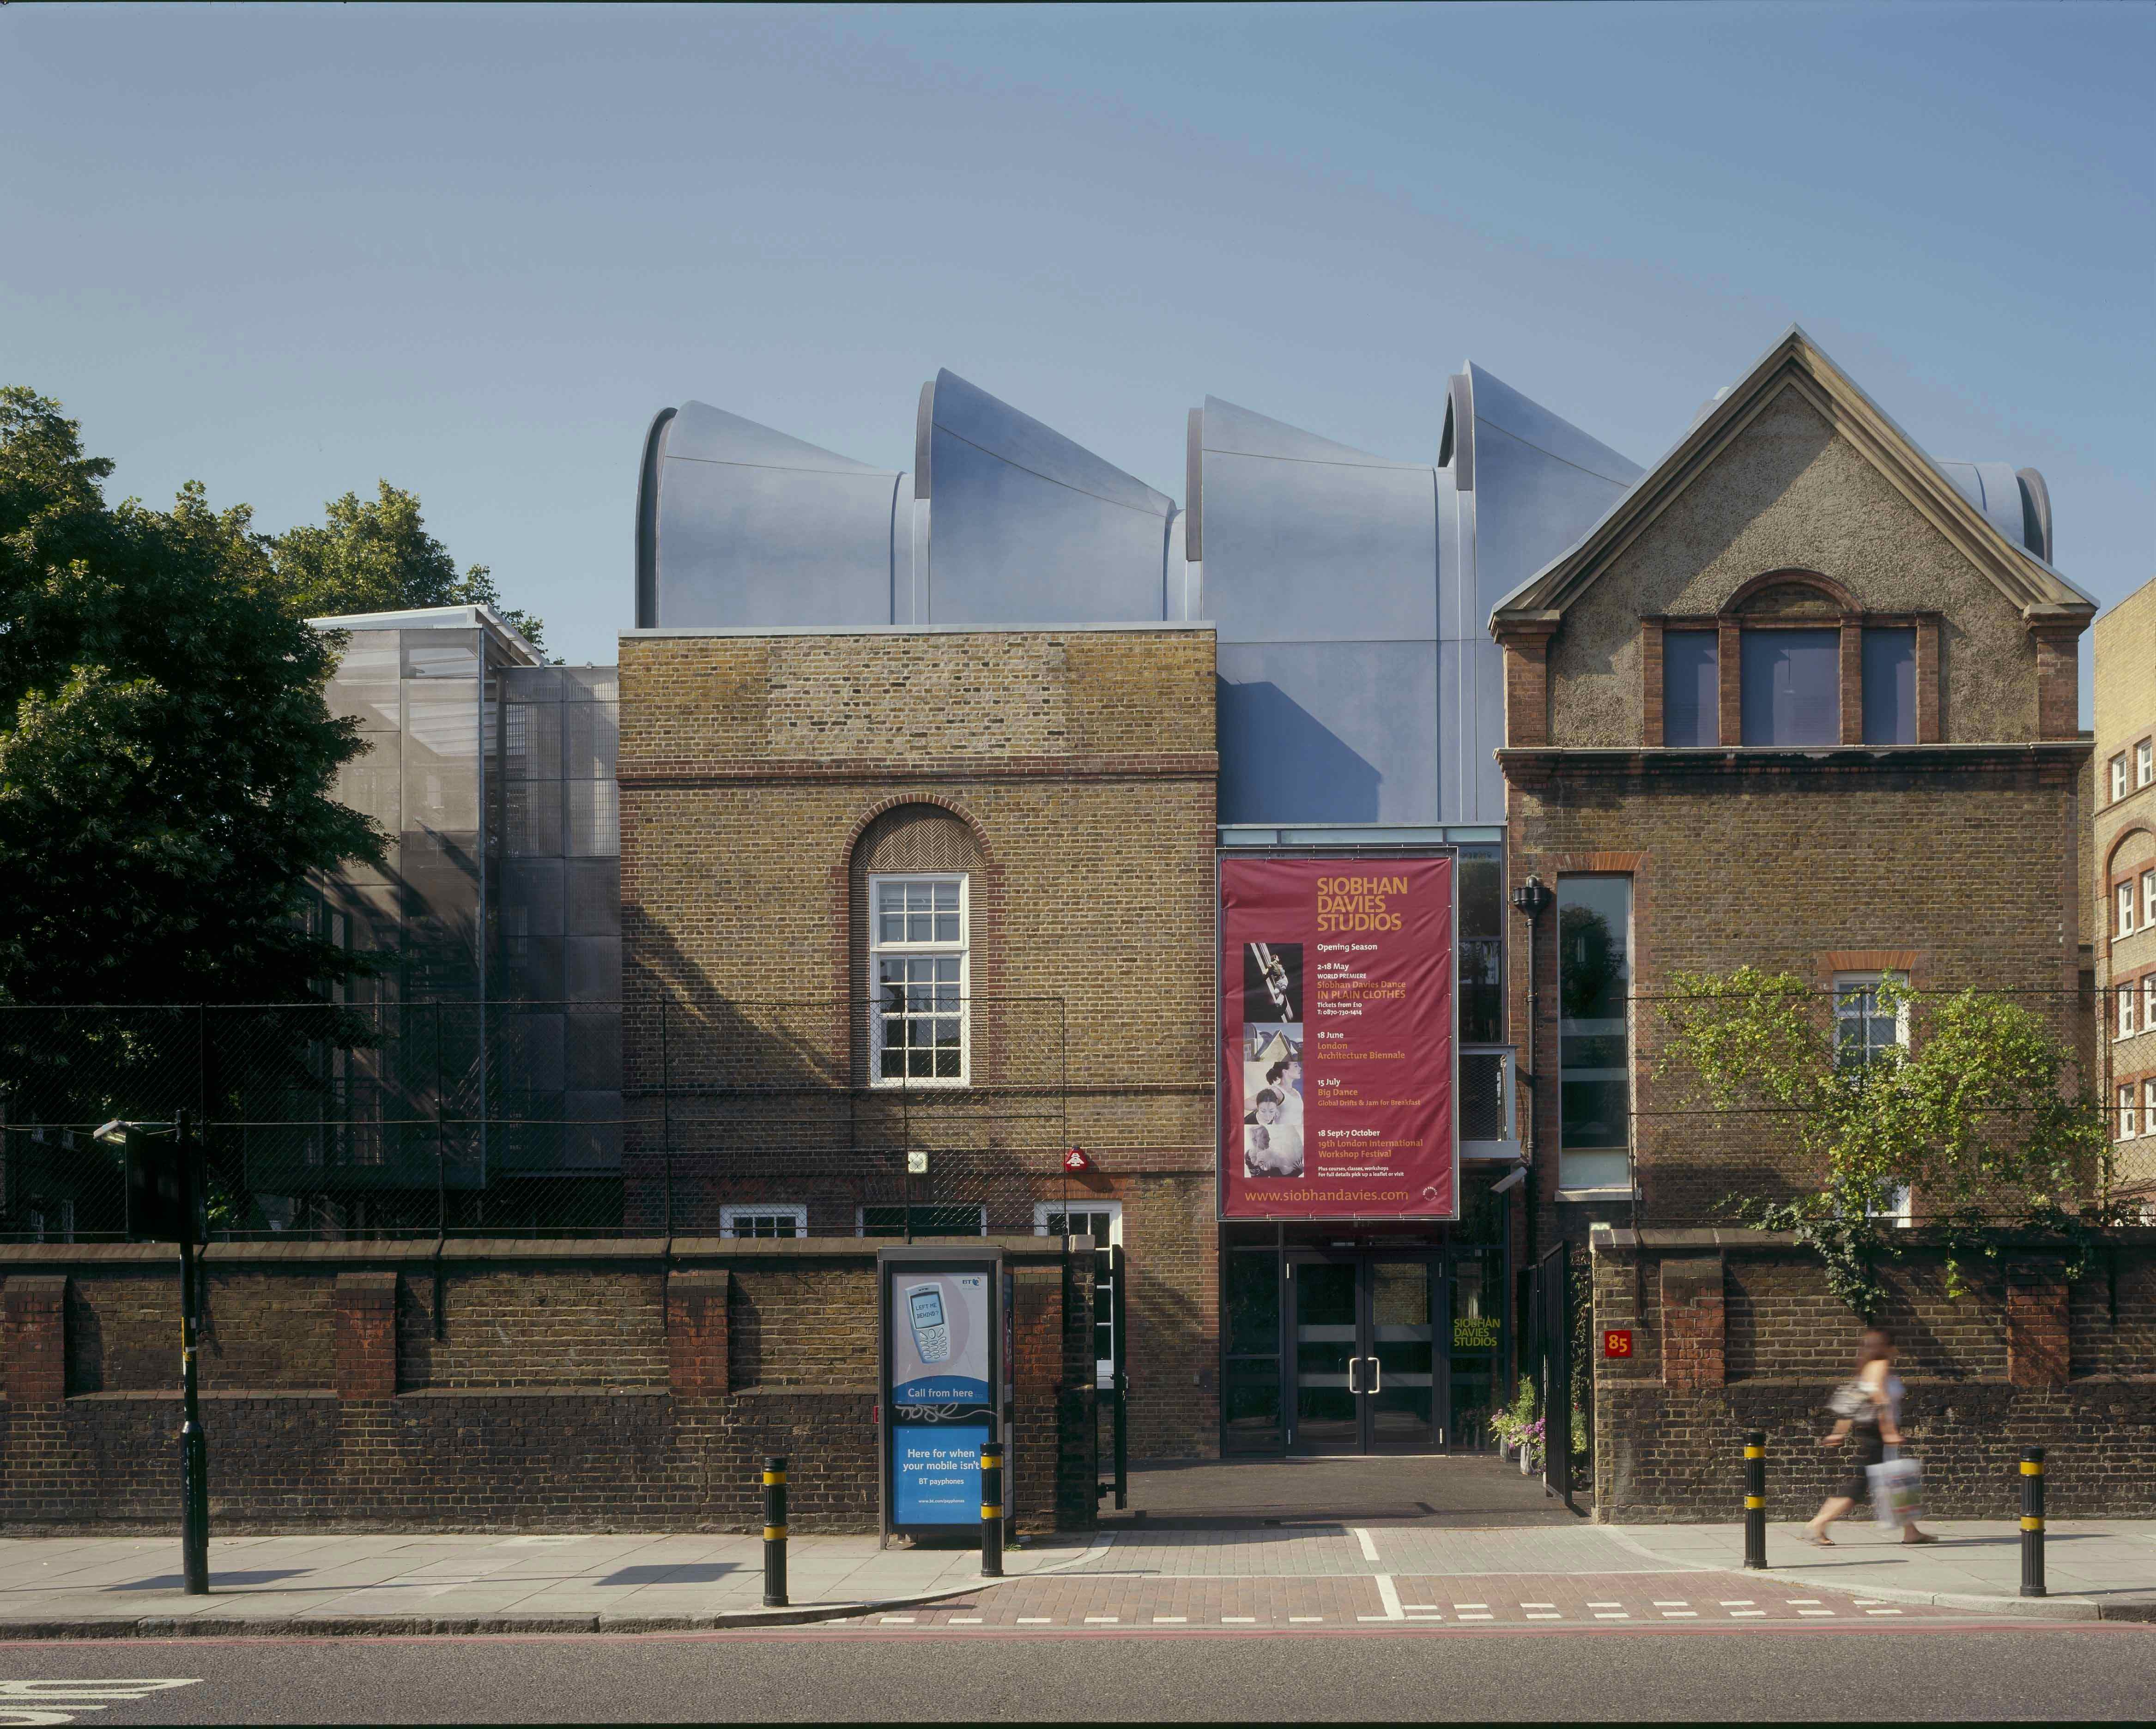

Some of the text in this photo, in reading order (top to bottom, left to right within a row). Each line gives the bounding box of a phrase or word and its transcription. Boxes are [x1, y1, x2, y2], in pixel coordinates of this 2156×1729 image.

[1317, 877, 1407, 894] SIOBHAN
[1318, 895, 1385, 913] DAVIES
[1318, 913, 1401, 931] STUDIOS
[1317, 943, 1350, 952] Opening
[1332, 991, 1360, 999] PLAIN
[1363, 990, 1405, 998] CLOTHES
[1318, 1089, 1331, 1097] Big
[1369, 1139, 1423, 1147] International
[1319, 1150, 1359, 1160] Workshop
[1245, 1189, 1408, 1201] www.siobhandavies.com
[1454, 1318, 1500, 1328] SIOBHAN
[1454, 1328, 1489, 1336] DAVIES
[1454, 1337, 1497, 1346] STUDIOS
[1609, 1335, 1627, 1352] 85
[908, 1389, 926, 1397] Call
[929, 1388, 950, 1397] from
[953, 1388, 973, 1397] here
[908, 1449, 975, 1458] Here for when
[903, 1461, 979, 1472] your mobile isn't
[930, 1478, 964, 1486] payphones
